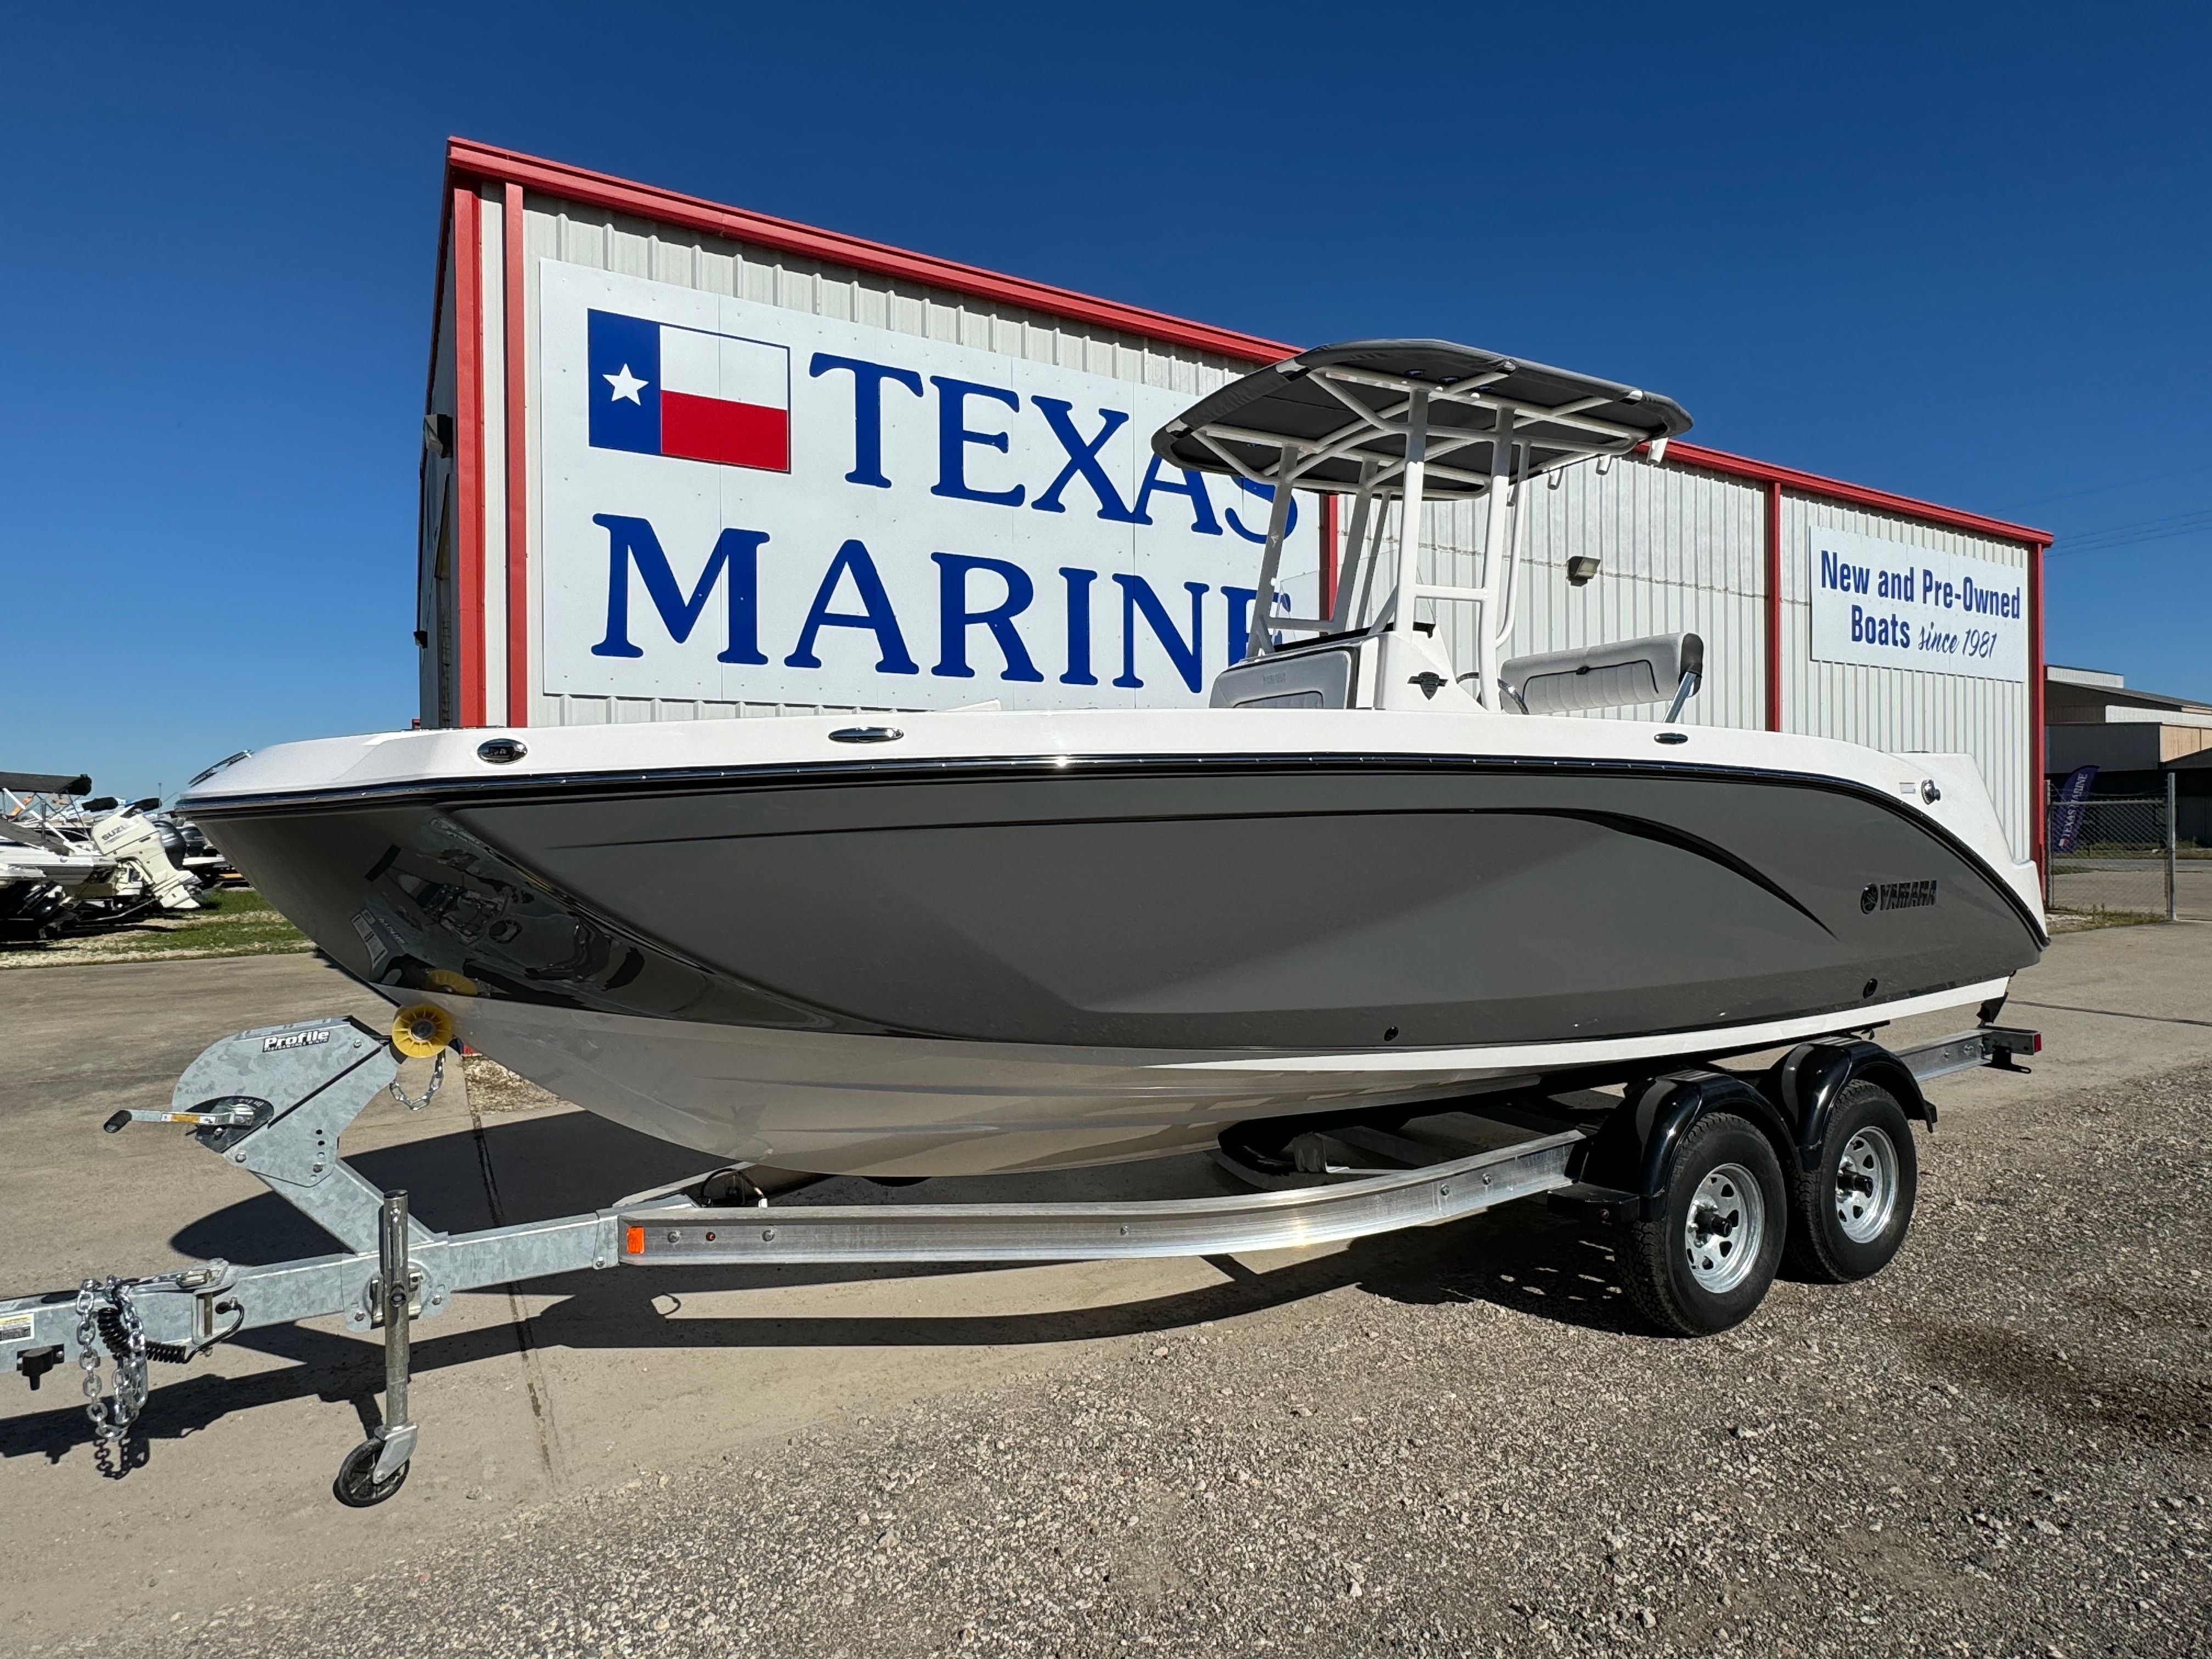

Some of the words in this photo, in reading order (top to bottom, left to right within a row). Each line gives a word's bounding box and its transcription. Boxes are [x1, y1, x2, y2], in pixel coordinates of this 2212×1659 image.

[1821, 550, 1870, 594] New
[1878, 567, 1914, 602] and
[1922, 569, 2020, 619] Pre-Owned
[1852, 604, 1910, 648] Boats
[1918, 622, 1960, 654] since
[1962, 629, 1997, 658] 1981
[1880, 880, 1937, 910] YAMAHA
[264, 1031, 329, 1048] Profile
